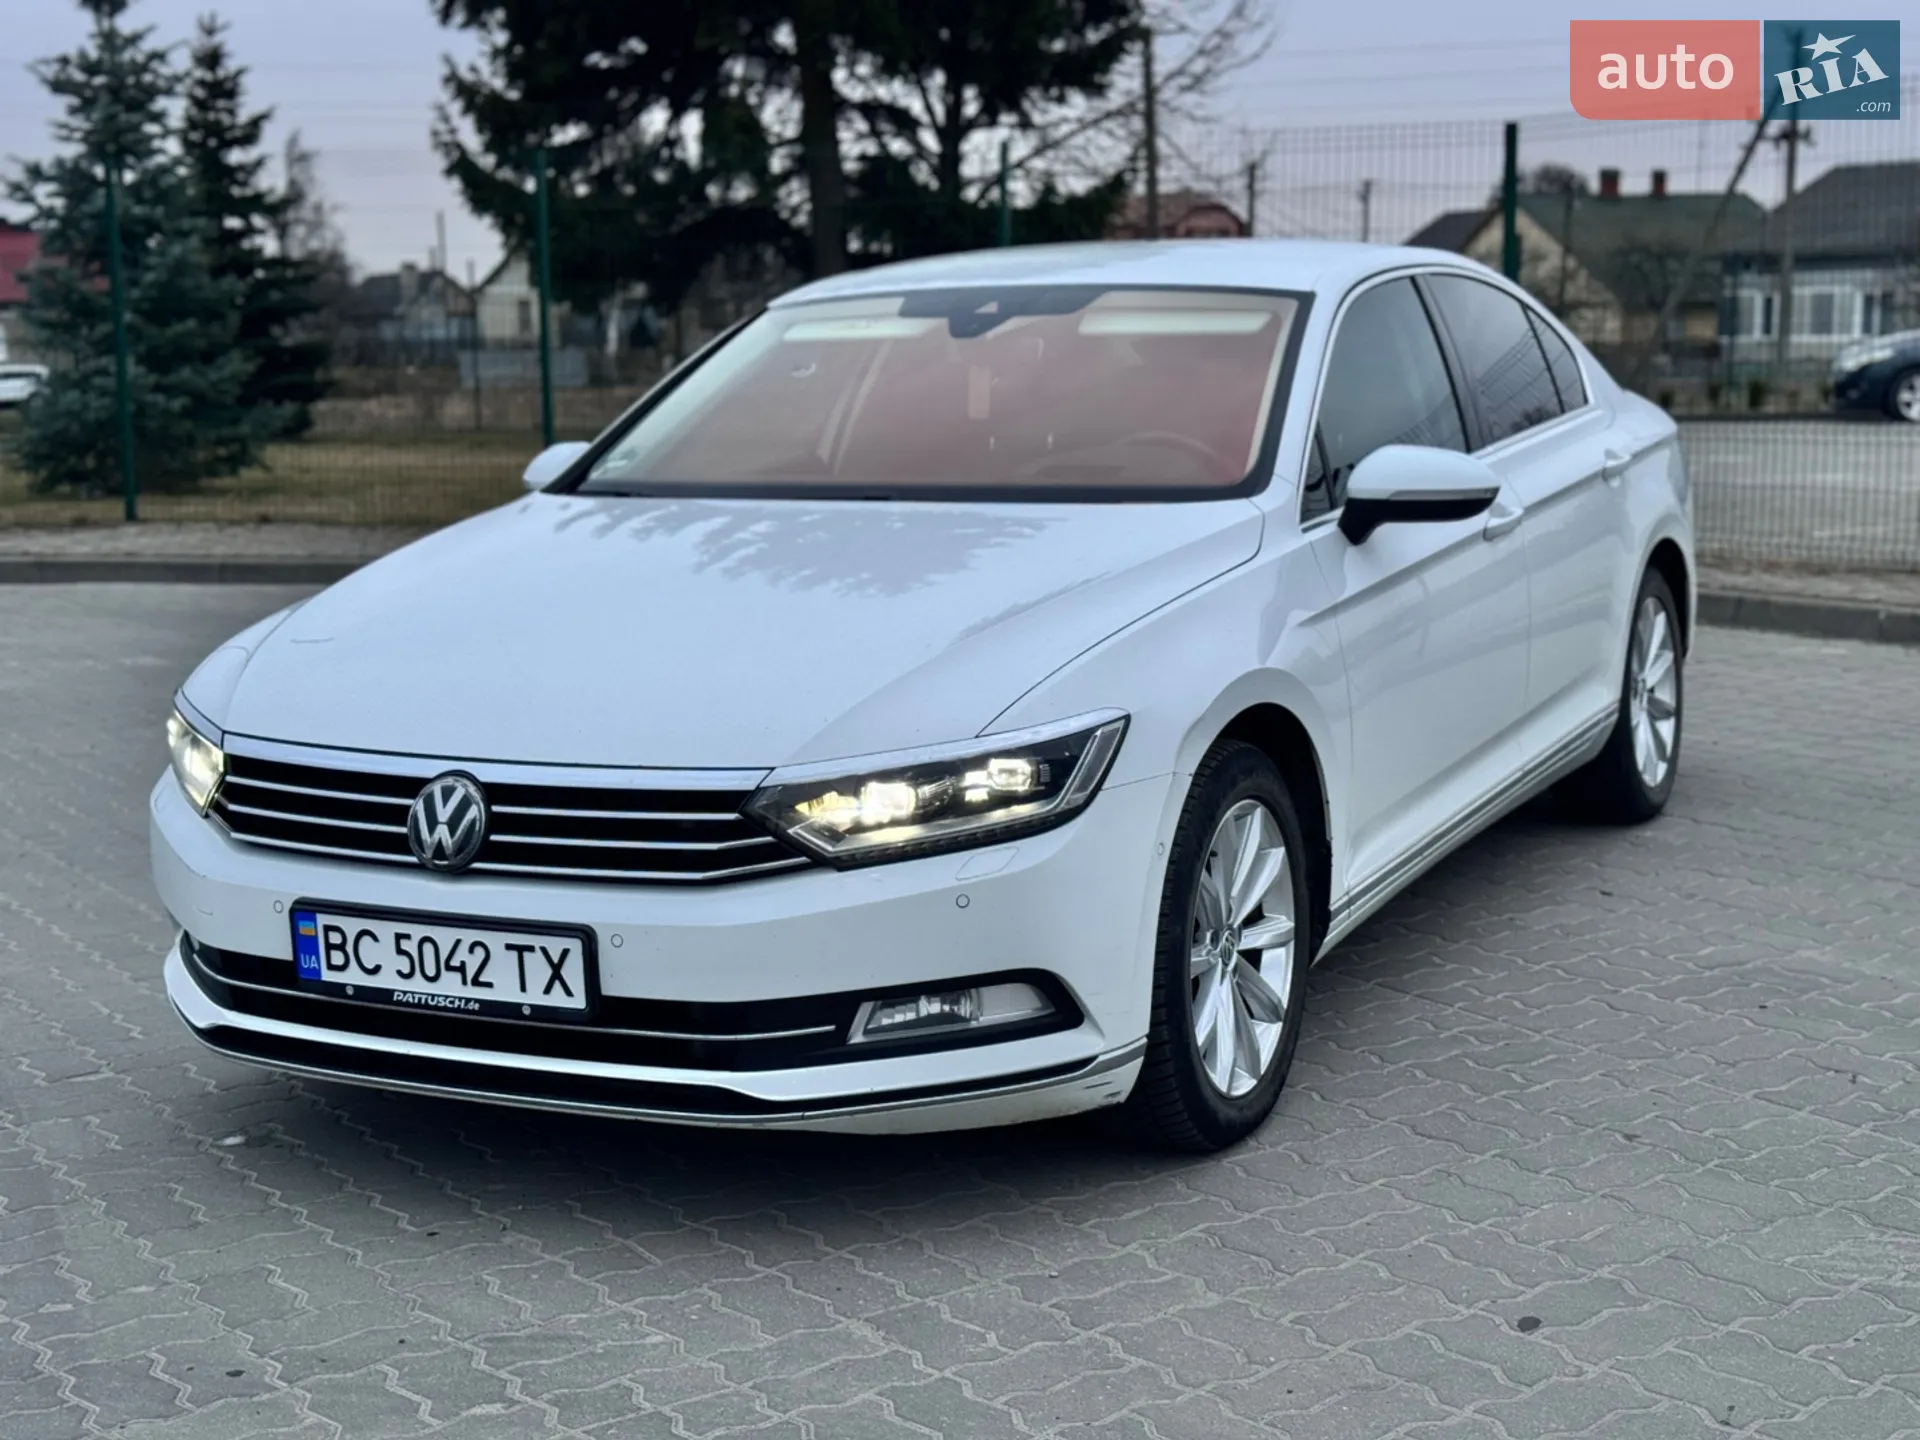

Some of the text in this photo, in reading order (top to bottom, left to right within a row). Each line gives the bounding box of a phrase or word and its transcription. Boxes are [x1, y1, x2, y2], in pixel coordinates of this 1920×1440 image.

[300, 953, 319, 970] UA
[322, 923, 575, 998] BC 5042 TX
[393, 991, 480, 1011] PATTUSCH.de
